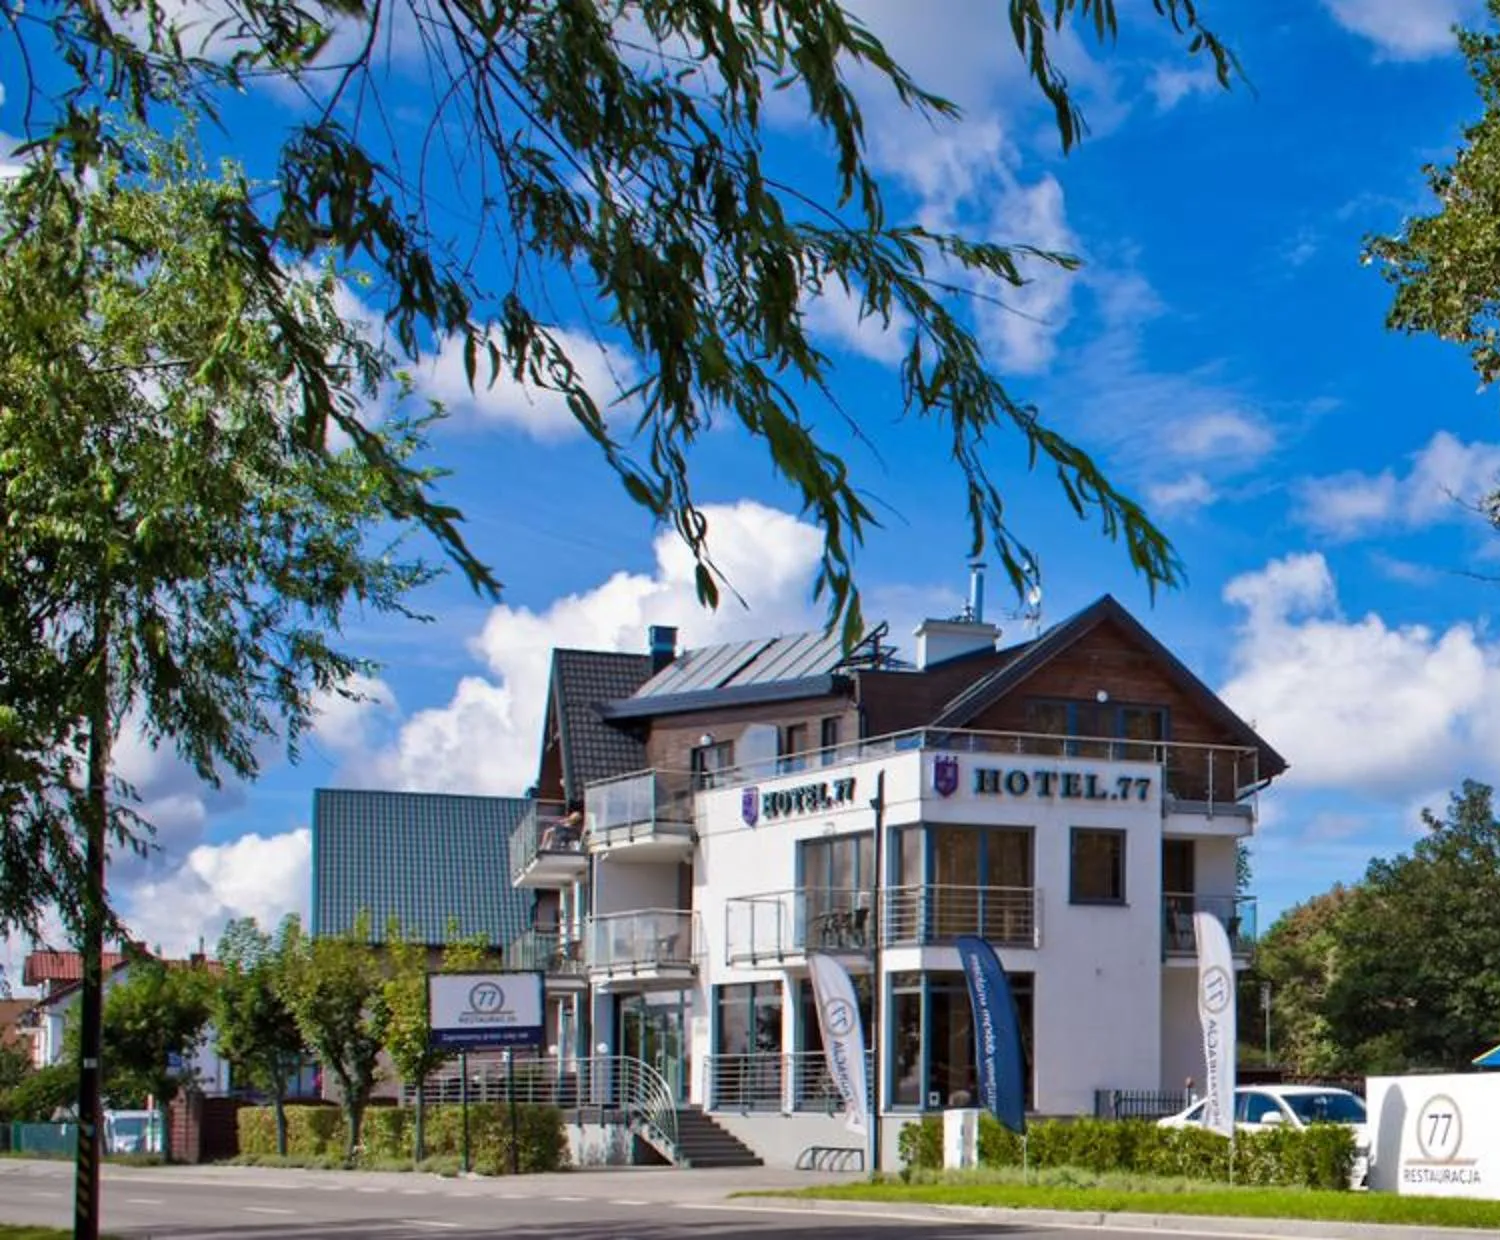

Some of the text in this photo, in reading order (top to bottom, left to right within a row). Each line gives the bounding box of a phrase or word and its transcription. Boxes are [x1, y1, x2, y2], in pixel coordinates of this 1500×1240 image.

[762, 777, 856, 820] HOTEL.77
[974, 768, 1151, 802] HOTEL.77
[478, 991, 497, 1007] 77
[1428, 1113, 1452, 1147] 77
[1403, 1168, 1481, 1185] RESTAURACJA
